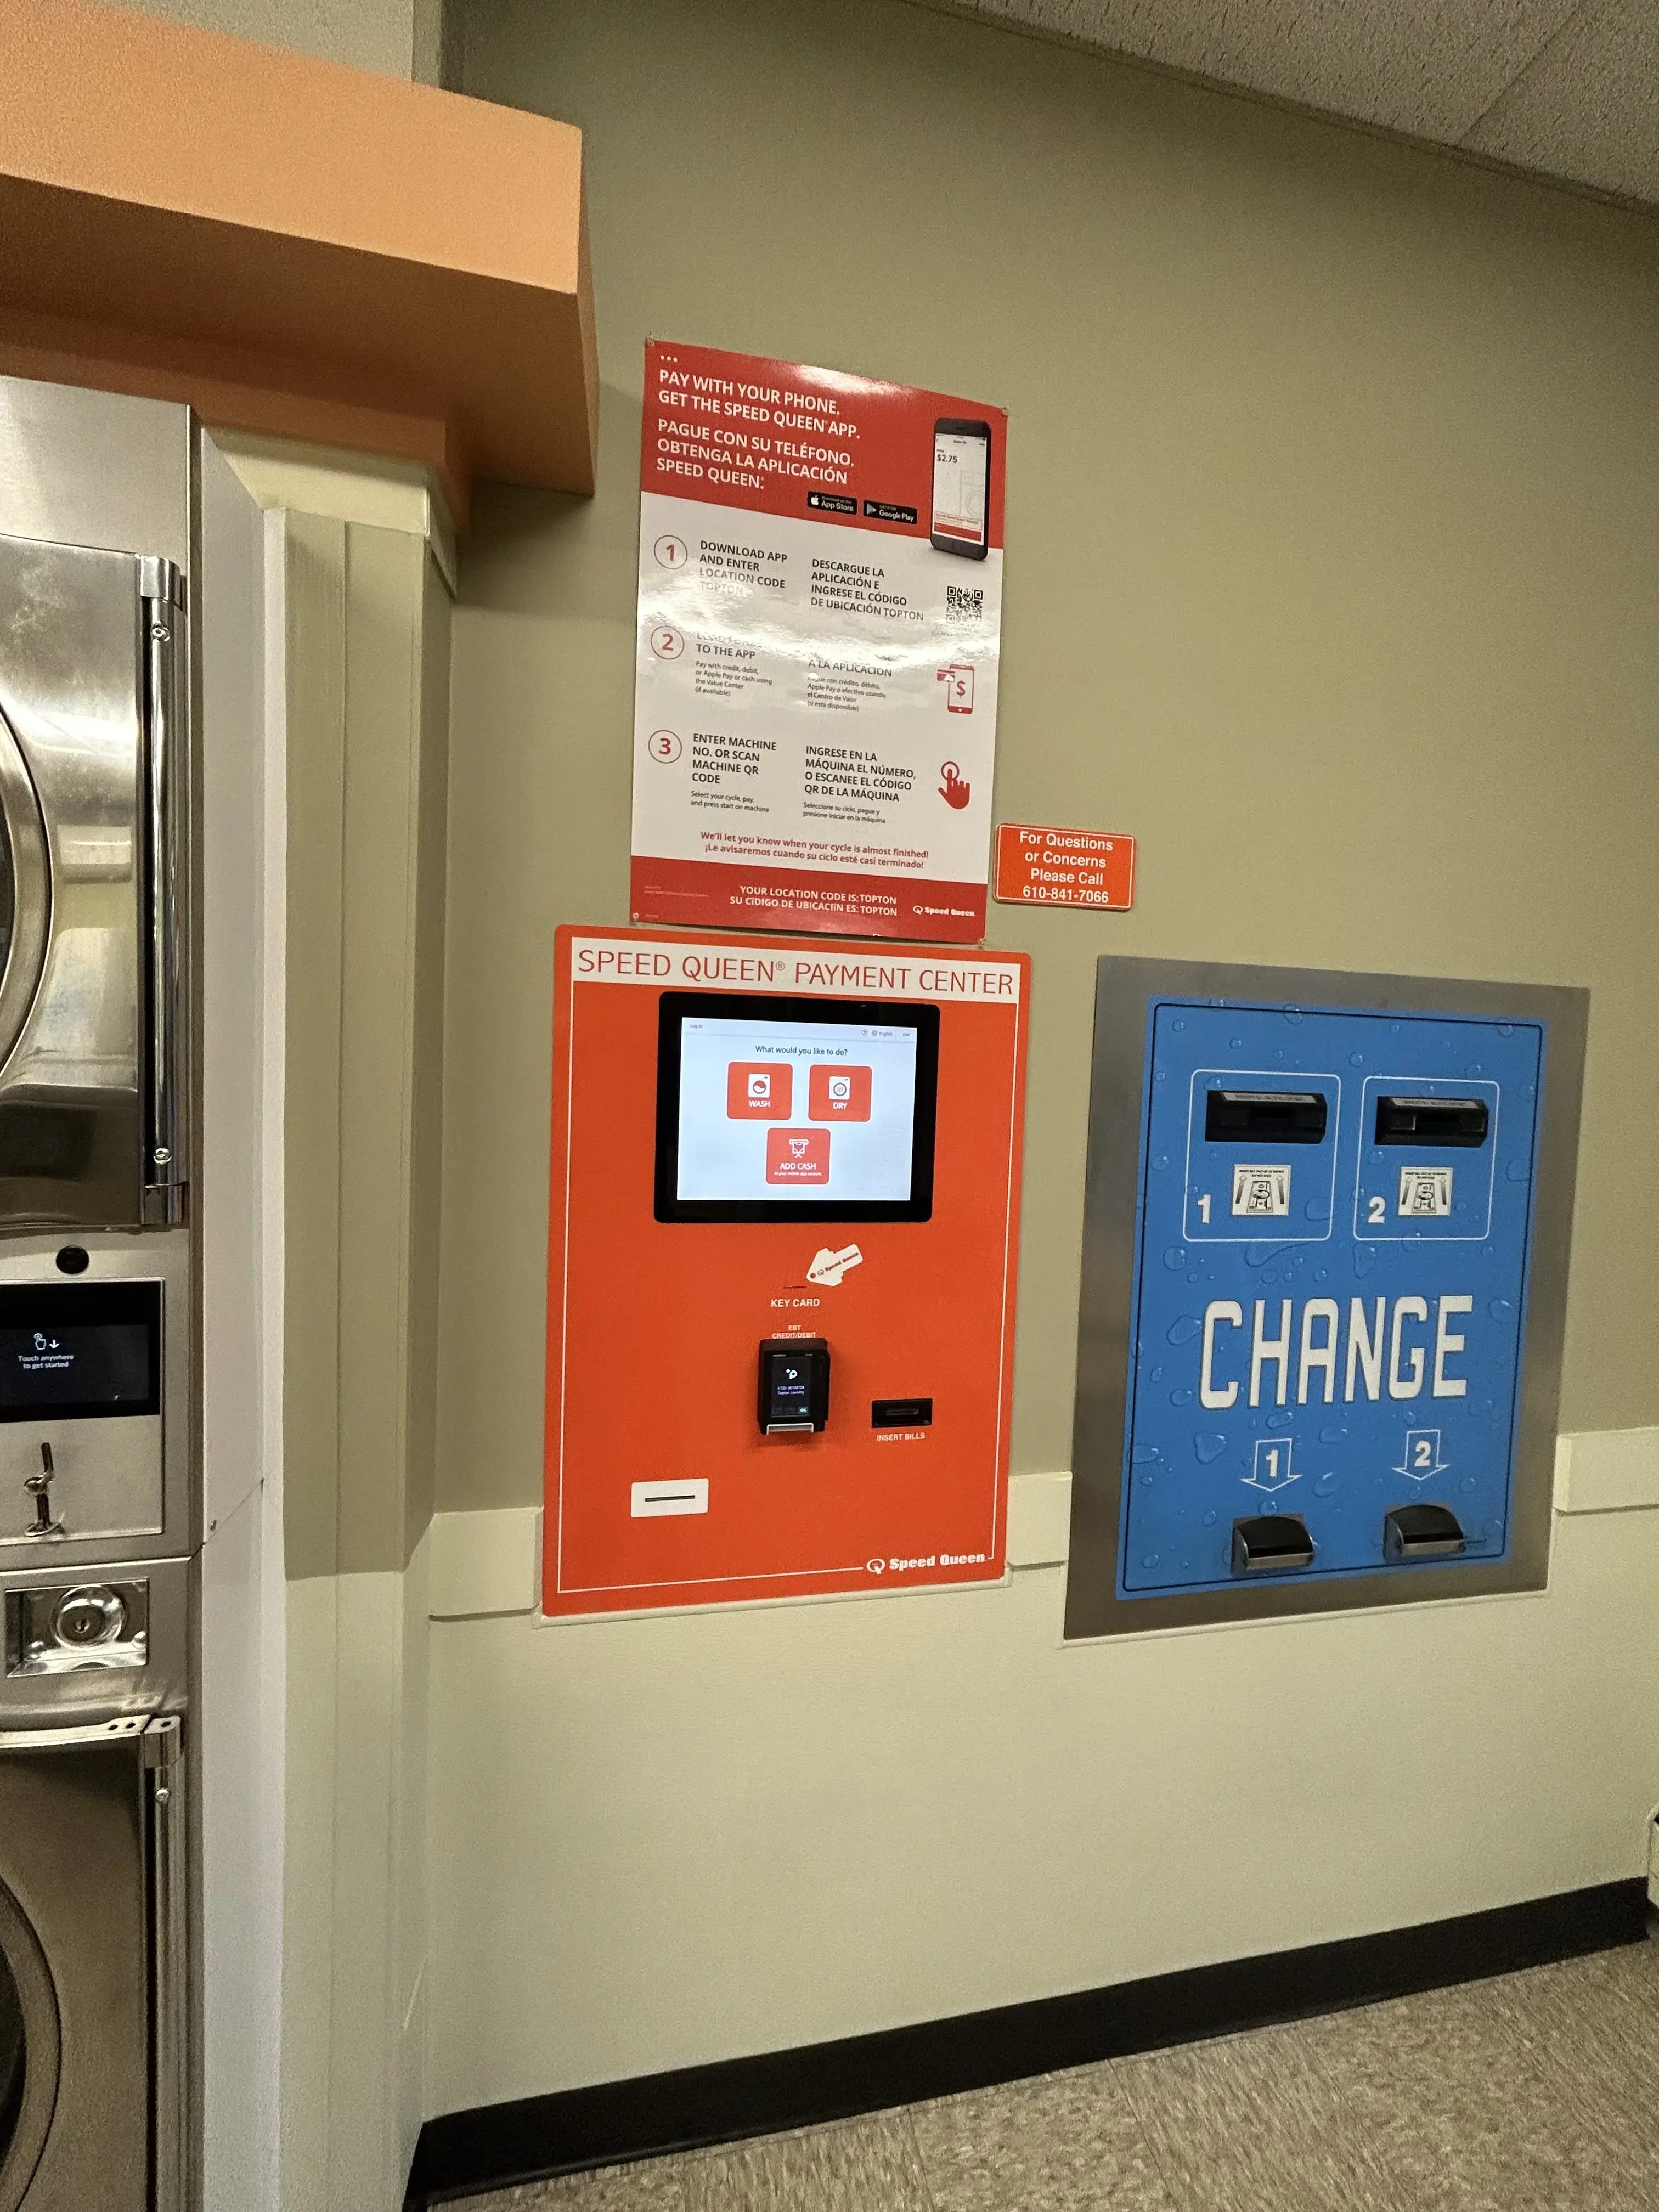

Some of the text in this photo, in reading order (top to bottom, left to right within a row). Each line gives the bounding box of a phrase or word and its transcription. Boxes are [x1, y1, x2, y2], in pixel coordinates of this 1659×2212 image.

[659, 369, 840, 415] PAY WITH YOUR PHONE.
[659, 390, 688, 407] GET
[691, 395, 720, 414] THE
[724, 402, 770, 422] SPEED
[828, 421, 860, 439] APP.
[658, 419, 854, 466] PAGUE CON SU TELÉFONO.
[657, 458, 703, 477] SPEED
[658, 439, 847, 484] OBTENGA LA APLICACIÓN
[937, 454, 957, 463] $2.75
[821, 500, 854, 511] App Store
[879, 510, 914, 522] Google Play
[667, 544, 674, 561] 1
[701, 540, 787, 562] DOWNLOAD APP
[699, 554, 760, 572] AND ENTER
[812, 558, 884, 577] DESCARGUE LA
[700, 567, 785, 588] LOCATION CODE
[811, 572, 871, 588] APLICACIÓN
[811, 585, 907, 606] INGRESE EL CÓDIGO
[811, 597, 924, 620] DE UBICACIÓN TOPTON
[662, 634, 673, 651] 2
[696, 644, 755, 658] TO THE APP
[819, 660, 830, 669] LA
[659, 738, 671, 754] 3
[693, 733, 777, 751] ENTER MACHINE
[693, 747, 760, 761] NO. OR SCAN
[806, 746, 877, 761] INGRESE EN LA
[692, 760, 759, 775] MACHINE QR
[805, 758, 916, 780] MÁQUINA EL NÚMERO,
[692, 773, 720, 783] CODE
[816, 773, 858, 785] ESCANEE
[861, 777, 871, 786] EL
[873, 778, 911, 790] CÓDIGO
[805, 785, 899, 802] QR DE LA MÁQUINA
[757, 837, 781, 845] know
[783, 840, 806, 848] when
[831, 844, 851, 853] cycle
[862, 847, 891, 855] almost
[893, 849, 929, 858] finished!
[1020, 831, 1113, 851] For Questions
[720, 845, 770, 856] avisaremos
[773, 850, 804, 858] cuando
[878, 859, 924, 868] terminado!
[1025, 851, 1106, 868] or Concerns
[1031, 868, 1103, 885] Please Call
[740, 886, 768, 895] YOUR
[770, 888, 818, 899] LOCATION
[821, 892, 845, 901] CODE
[859, 894, 896, 904] TOPTON
[1023, 885, 1109, 903] 610-841-7066
[860, 906, 897, 916] TOPTON
[924, 907, 949, 915] Speed
[578, 950, 671, 977] SPEED
[795, 962, 911, 989] PAYMENT
[919, 970, 1013, 995] CENTER
[1197, 1194, 1211, 1223] 1
[1367, 1197, 1385, 1223] 2
[771, 1299, 820, 1307] KEY CARD
[1199, 1295, 1473, 1410] CHANGE
[1265, 1449, 1279, 1477] 1
[1414, 1441, 1431, 1467] 2
[889, 1556, 935, 1571] Speed
[940, 1554, 985, 1565] Queen
